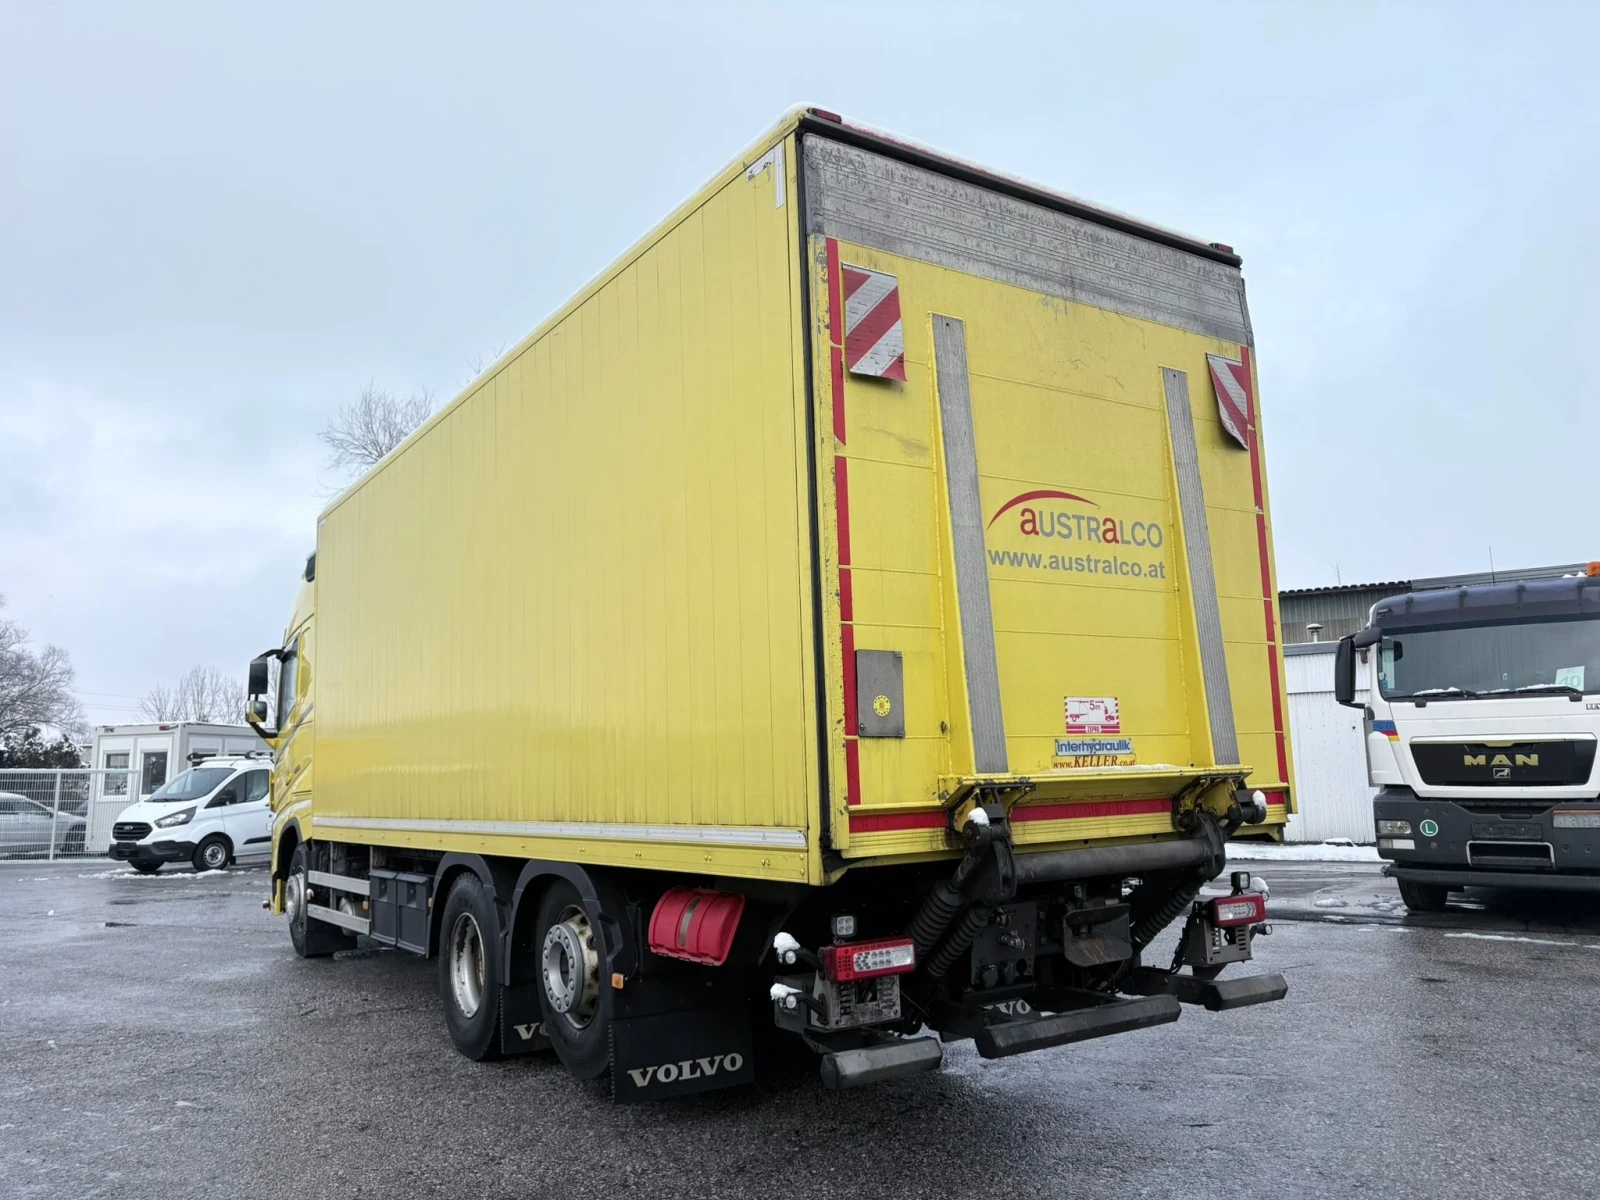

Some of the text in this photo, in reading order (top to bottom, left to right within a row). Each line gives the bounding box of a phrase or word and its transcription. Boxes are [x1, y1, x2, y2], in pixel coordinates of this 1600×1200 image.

[988, 550, 1166, 579] www.australco.at
[1057, 739, 1131, 753] interhydraulik
[1463, 754, 1539, 767] MAN
[627, 1052, 745, 1088] VOLVO
